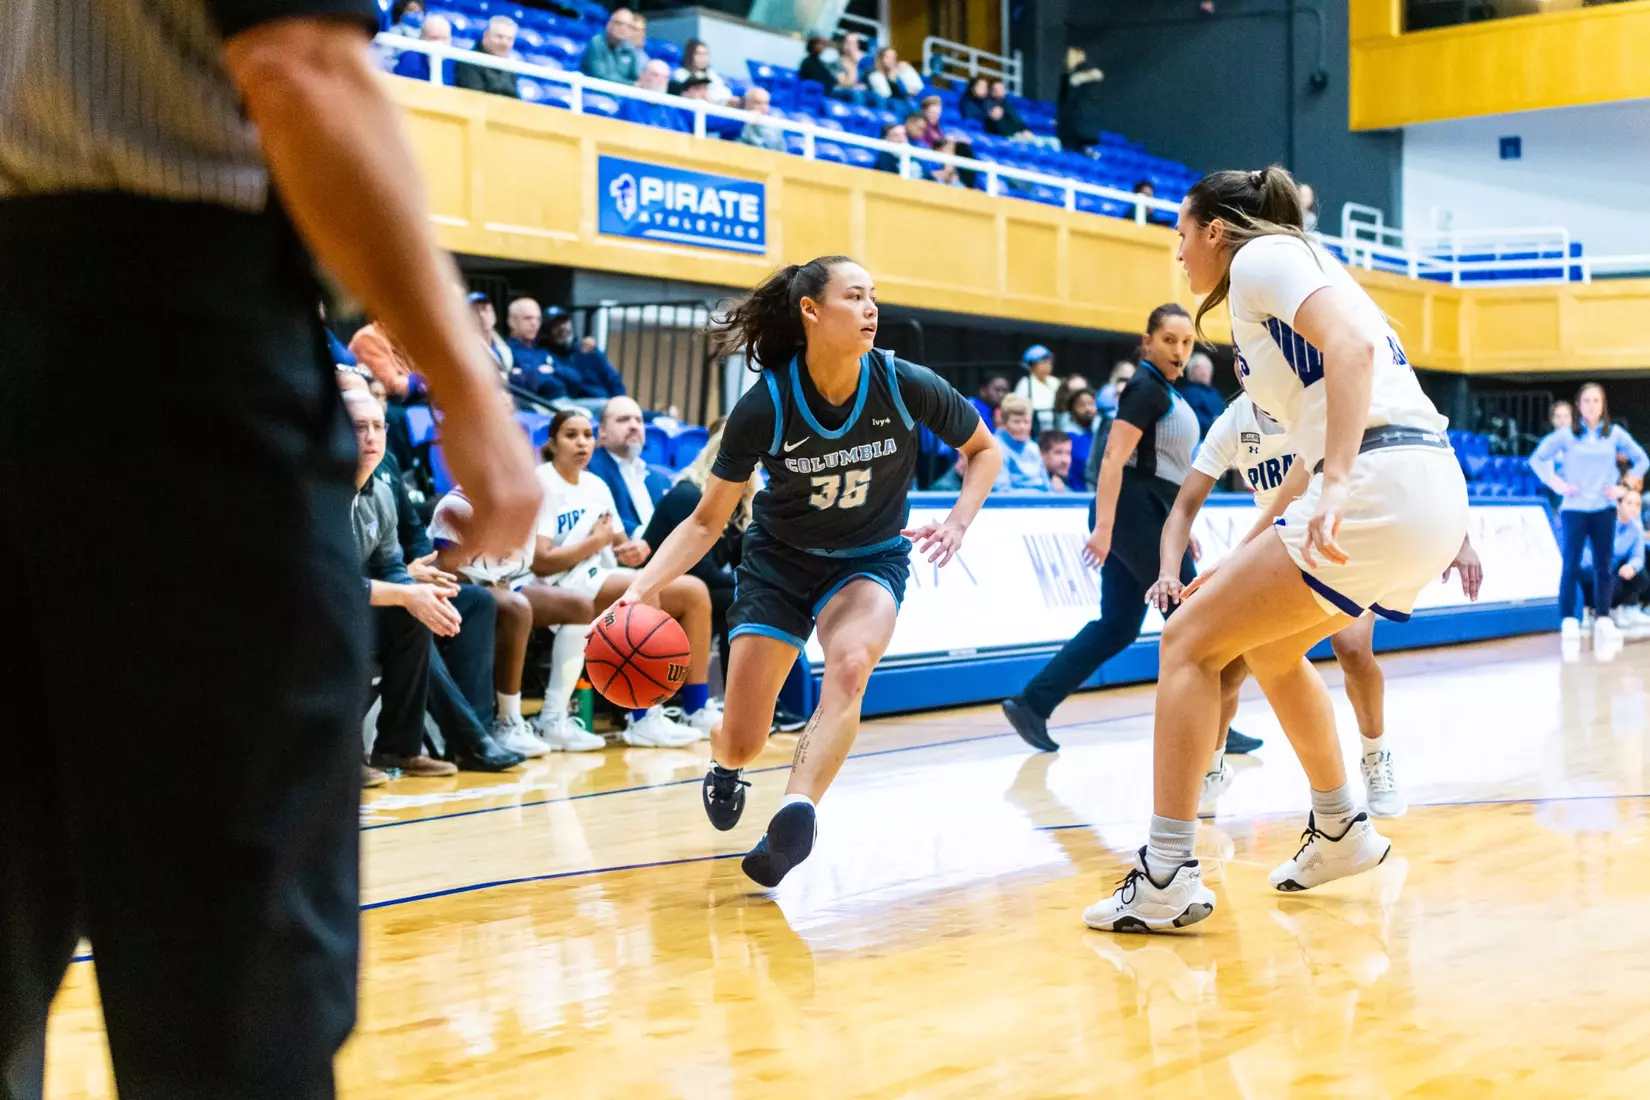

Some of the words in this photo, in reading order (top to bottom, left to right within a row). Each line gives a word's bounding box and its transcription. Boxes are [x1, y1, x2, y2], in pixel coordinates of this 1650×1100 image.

[640, 177, 760, 223] PIRATE
[785, 438, 897, 473] COLUMBIA
[1248, 453, 1297, 491] PIRA
[809, 467, 872, 510] 35
[557, 508, 587, 534] PIR
